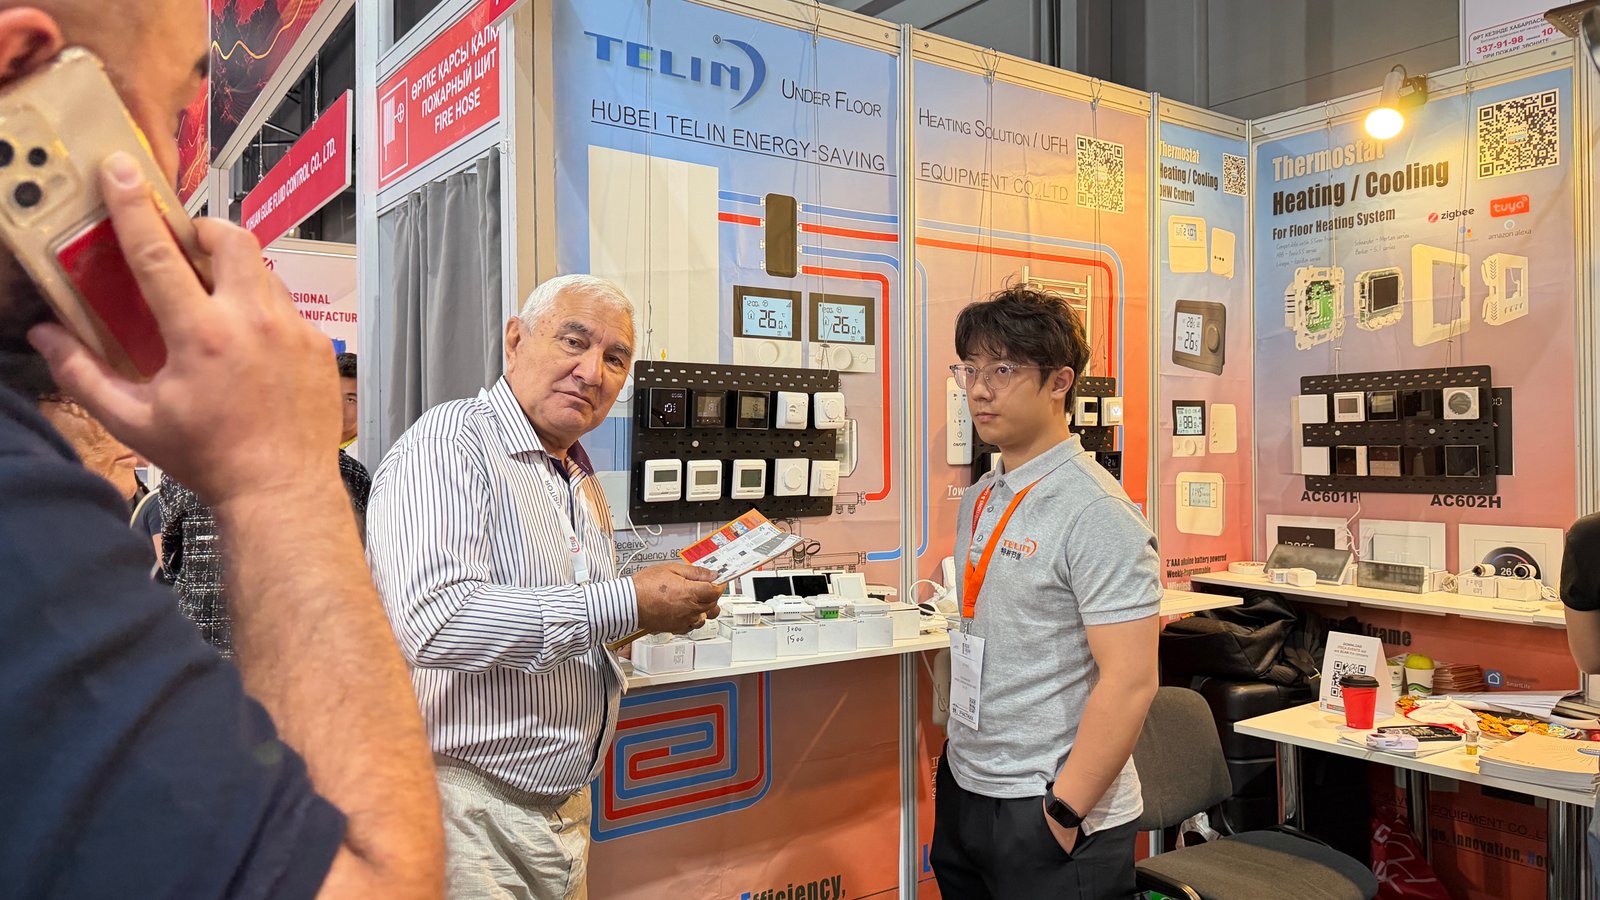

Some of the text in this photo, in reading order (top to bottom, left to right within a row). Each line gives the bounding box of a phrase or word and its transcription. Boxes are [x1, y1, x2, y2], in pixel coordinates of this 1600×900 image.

[1476, 35, 1524, 54] 337-91-98
[411, 67, 436, 100] ӨРТКЕ
[471, 25, 500, 57] ҚАЛҚ
[583, 30, 741, 91] TELIN
[421, 47, 497, 118] ПОЖАРНЫЙ ЩИТ
[434, 86, 481, 134] FIRE HOSE
[591, 98, 885, 172] HUBEI TELIN ENERGY-SAVING
[1041, 133, 1069, 155] UFH
[1160, 140, 1200, 164] Thermostat
[1272, 139, 1385, 182] Thermostat
[286, 161, 310, 197] CONTROL
[323, 137, 336, 164] LTD.
[921, 162, 1009, 192] EQUIPMENT
[1192, 169, 1219, 191] Cooling
[1272, 181, 1345, 216] Heating
[1365, 160, 1449, 198] Cooling
[1173, 187, 1195, 202] Control
[1493, 199, 1525, 214] tuya
[1272, 208, 1396, 241] For Floor Heating System
[1440, 206, 1475, 221] zigbee
[1488, 228, 1532, 240] amazon alexa
[289, 291, 331, 305] SIONAL
[299, 309, 358, 323] ANUFACTUR
[1430, 494, 1502, 509] AC602H
[622, 550, 668, 562] Frequency
[1209, 553, 1227, 563] powered
[1366, 623, 1412, 647] frame
[1431, 804, 1504, 829] EQUIPMENT
[741, 874, 846, 900] iency,
